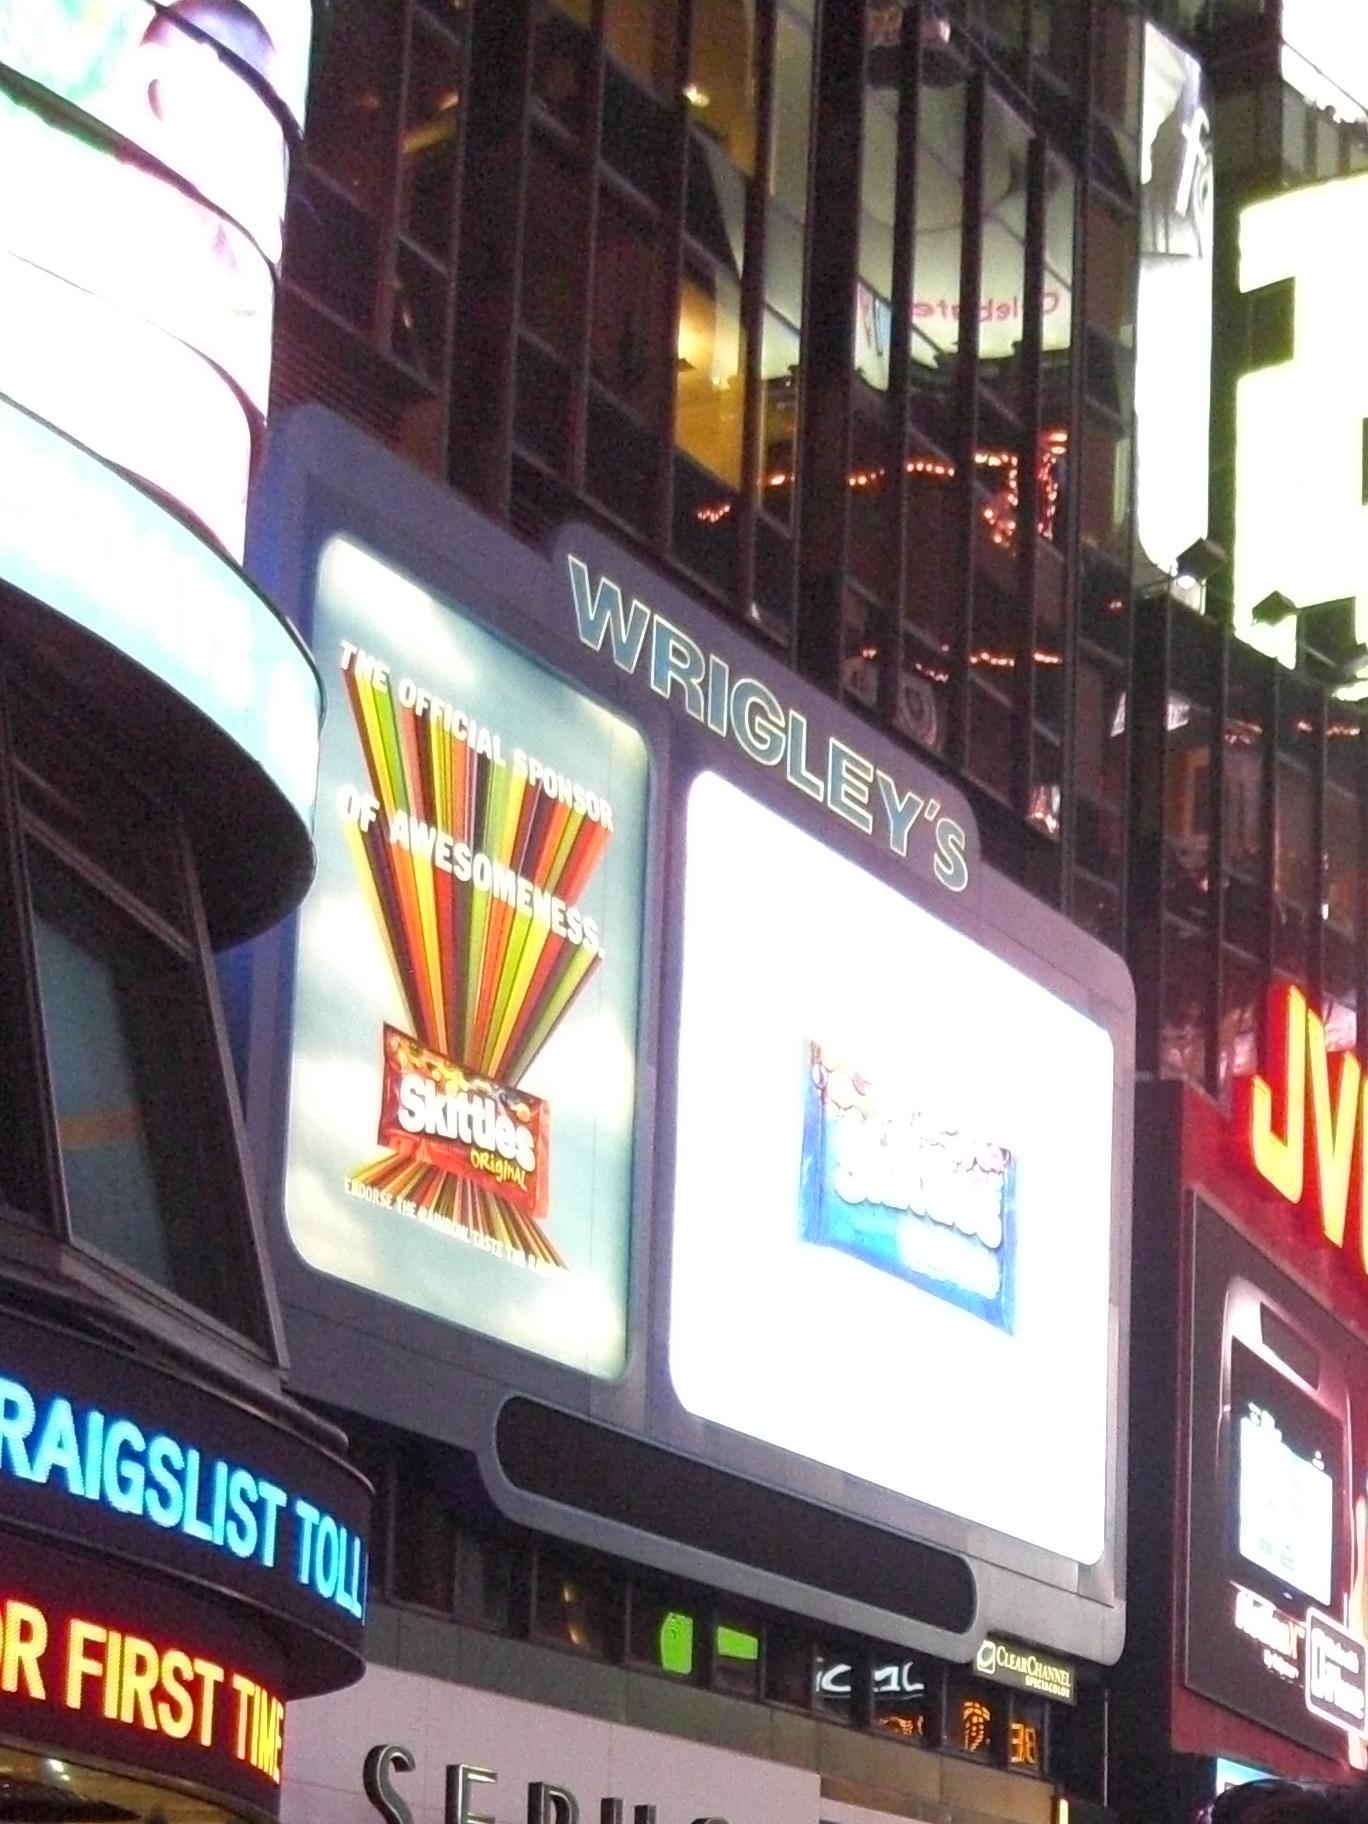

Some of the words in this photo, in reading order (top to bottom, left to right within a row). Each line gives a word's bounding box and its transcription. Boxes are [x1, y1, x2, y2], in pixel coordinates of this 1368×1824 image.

[339, 640, 391, 694] THE
[399, 678, 507, 768] OFFICIAL
[513, 748, 615, 833] SPONSOR
[567, 553, 969, 892] WRIGLEY'S
[336, 783, 380, 833] OF
[389, 808, 606, 958] AWESOMENESS.
[343, 1177, 394, 1211] ENDORSE
[396, 1195, 417, 1219] THE
[398, 1073, 537, 1172] Skittles
[0, 1377, 287, 1569] RAIGSLIST
[66, 1618, 225, 1748] FIRST
